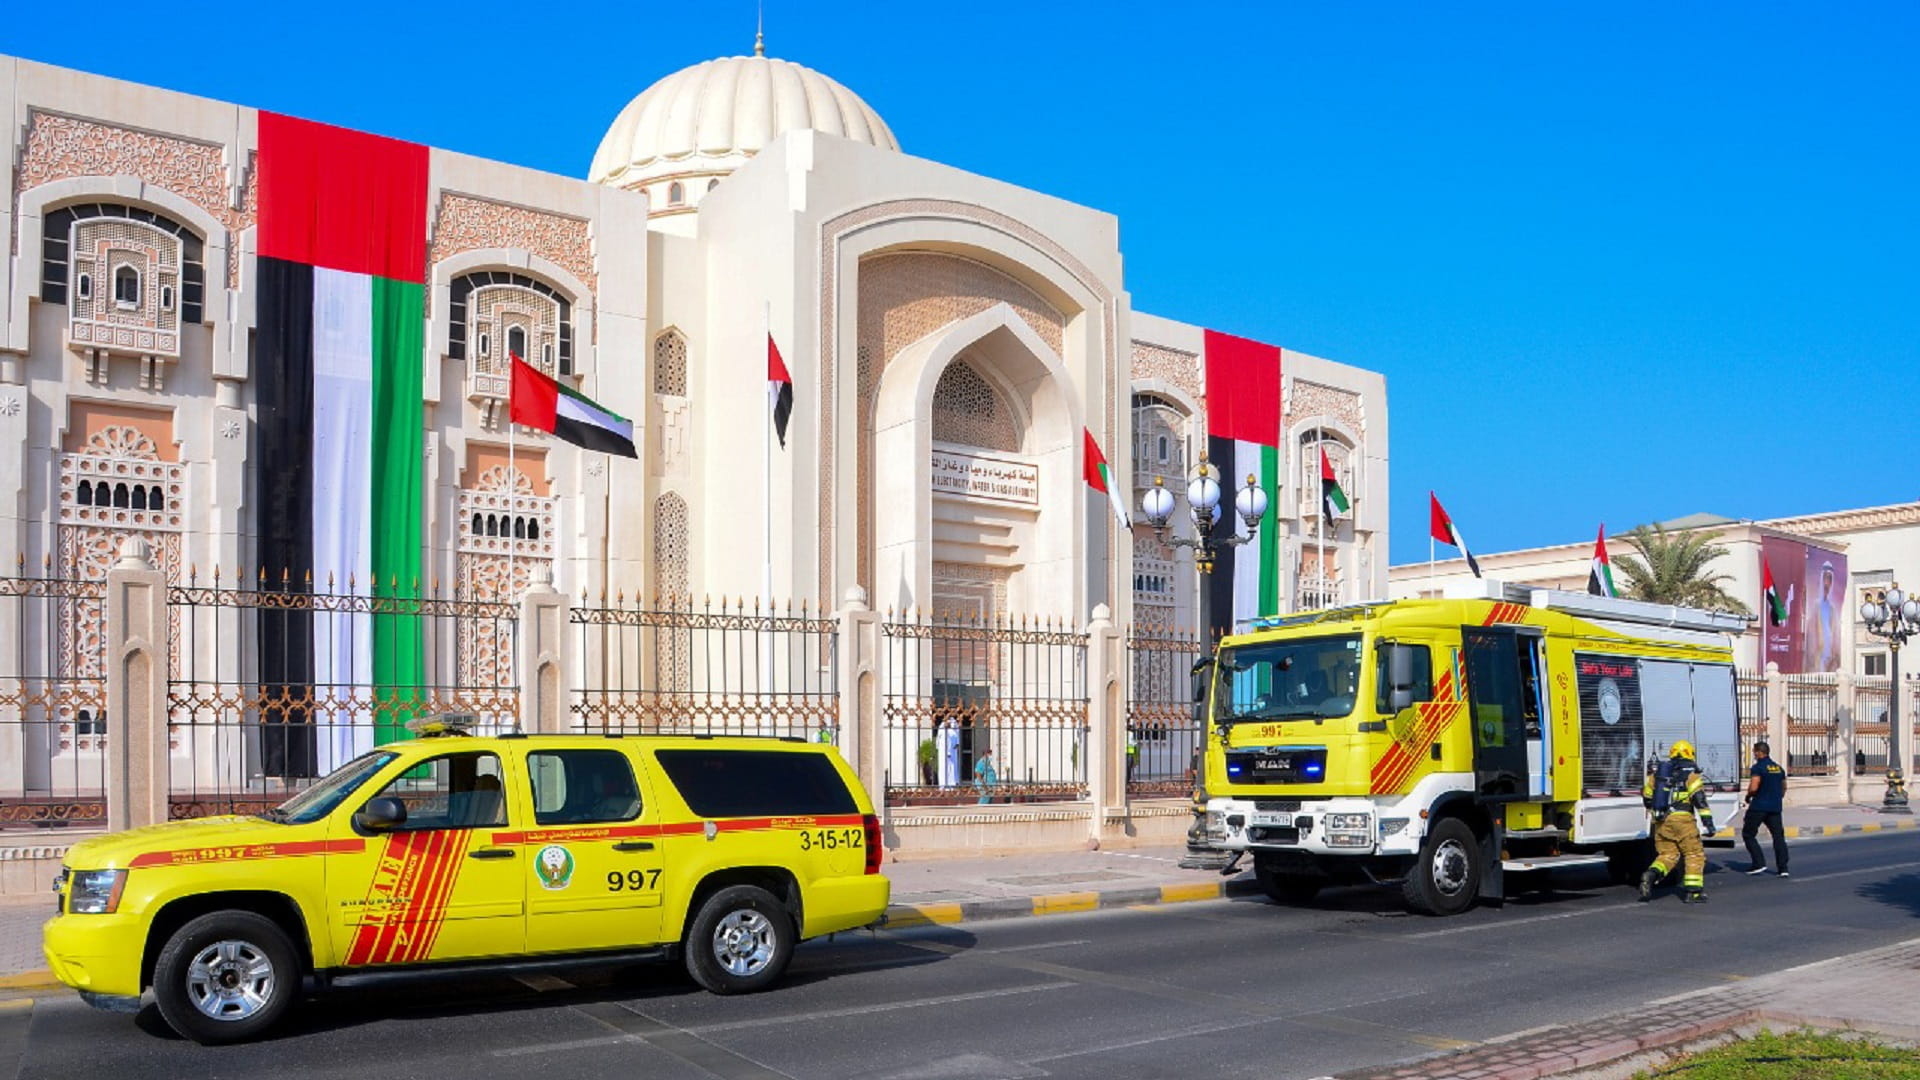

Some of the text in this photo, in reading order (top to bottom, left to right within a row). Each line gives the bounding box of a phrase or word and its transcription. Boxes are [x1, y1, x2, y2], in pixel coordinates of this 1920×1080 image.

[941, 458, 964, 474] وغاز
[965, 463, 988, 478] ومياه
[989, 468, 1017, 481] كهرباء
[1019, 469, 1035, 484] هيئة
[1261, 725, 1282, 738] 997
[1255, 759, 1291, 769] MAN
[799, 829, 863, 851] 3-15-12
[199, 847, 247, 860] 997
[607, 869, 663, 892] 997
